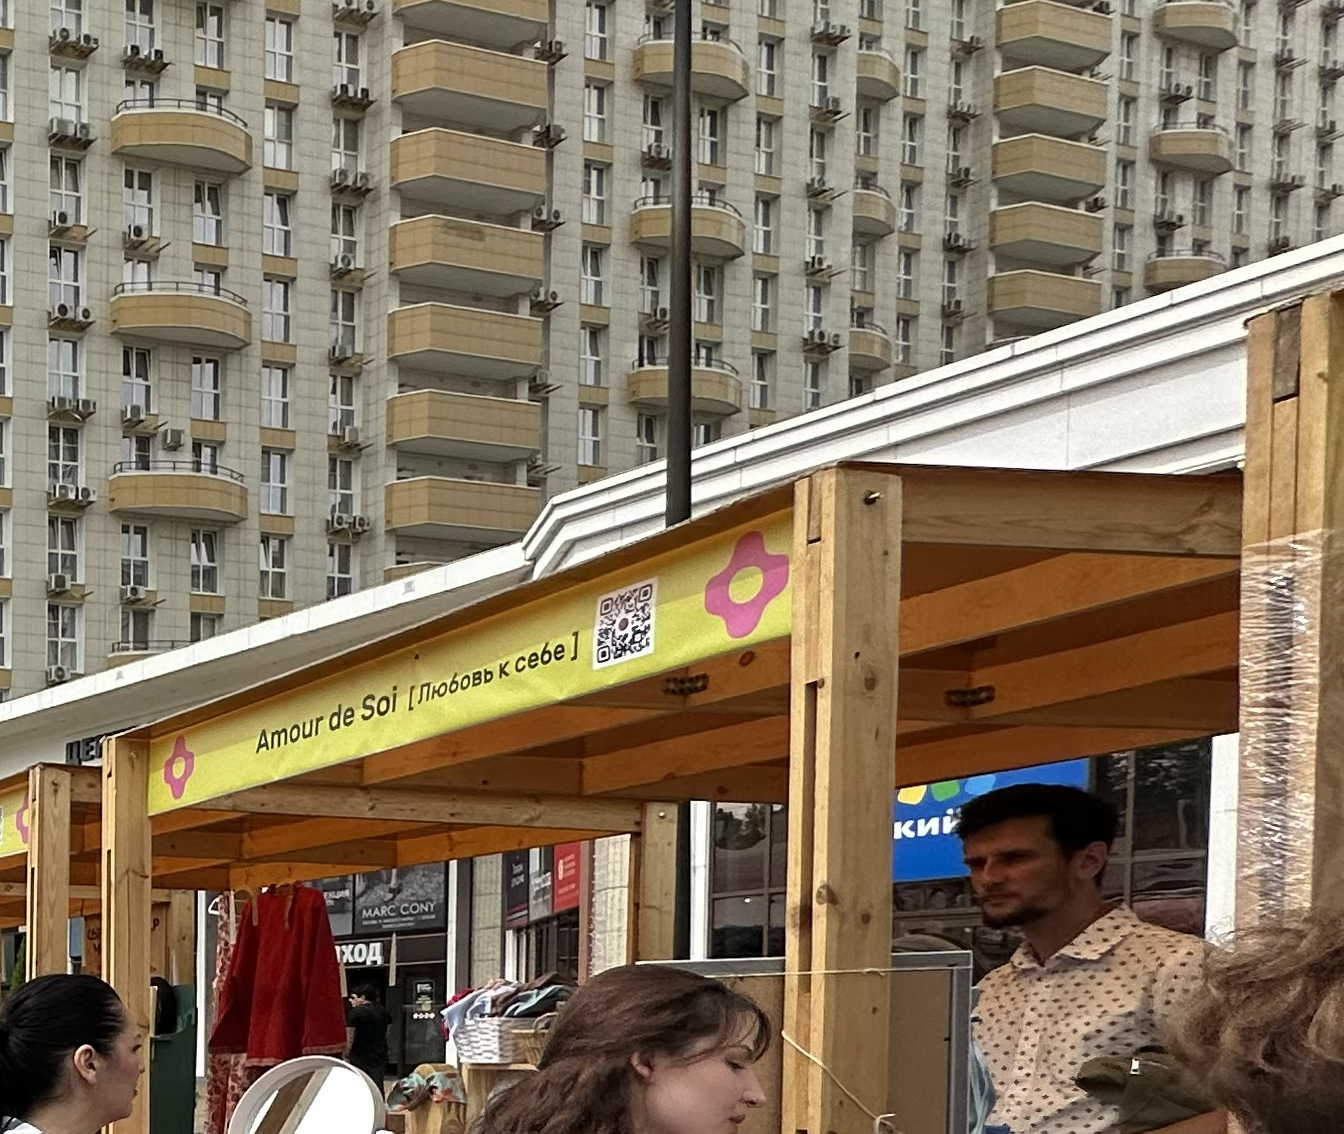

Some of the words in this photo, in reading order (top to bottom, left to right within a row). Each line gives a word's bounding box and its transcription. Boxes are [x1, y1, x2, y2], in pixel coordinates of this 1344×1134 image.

[256, 715, 324, 754] Amour
[328, 704, 355, 731] de
[361, 686, 398, 721] Soi
[893, 807, 962, 840] кий
[362, 905, 396, 919] MARC
[400, 901, 436, 915] CONY
[335, 942, 384, 967] ХОД
